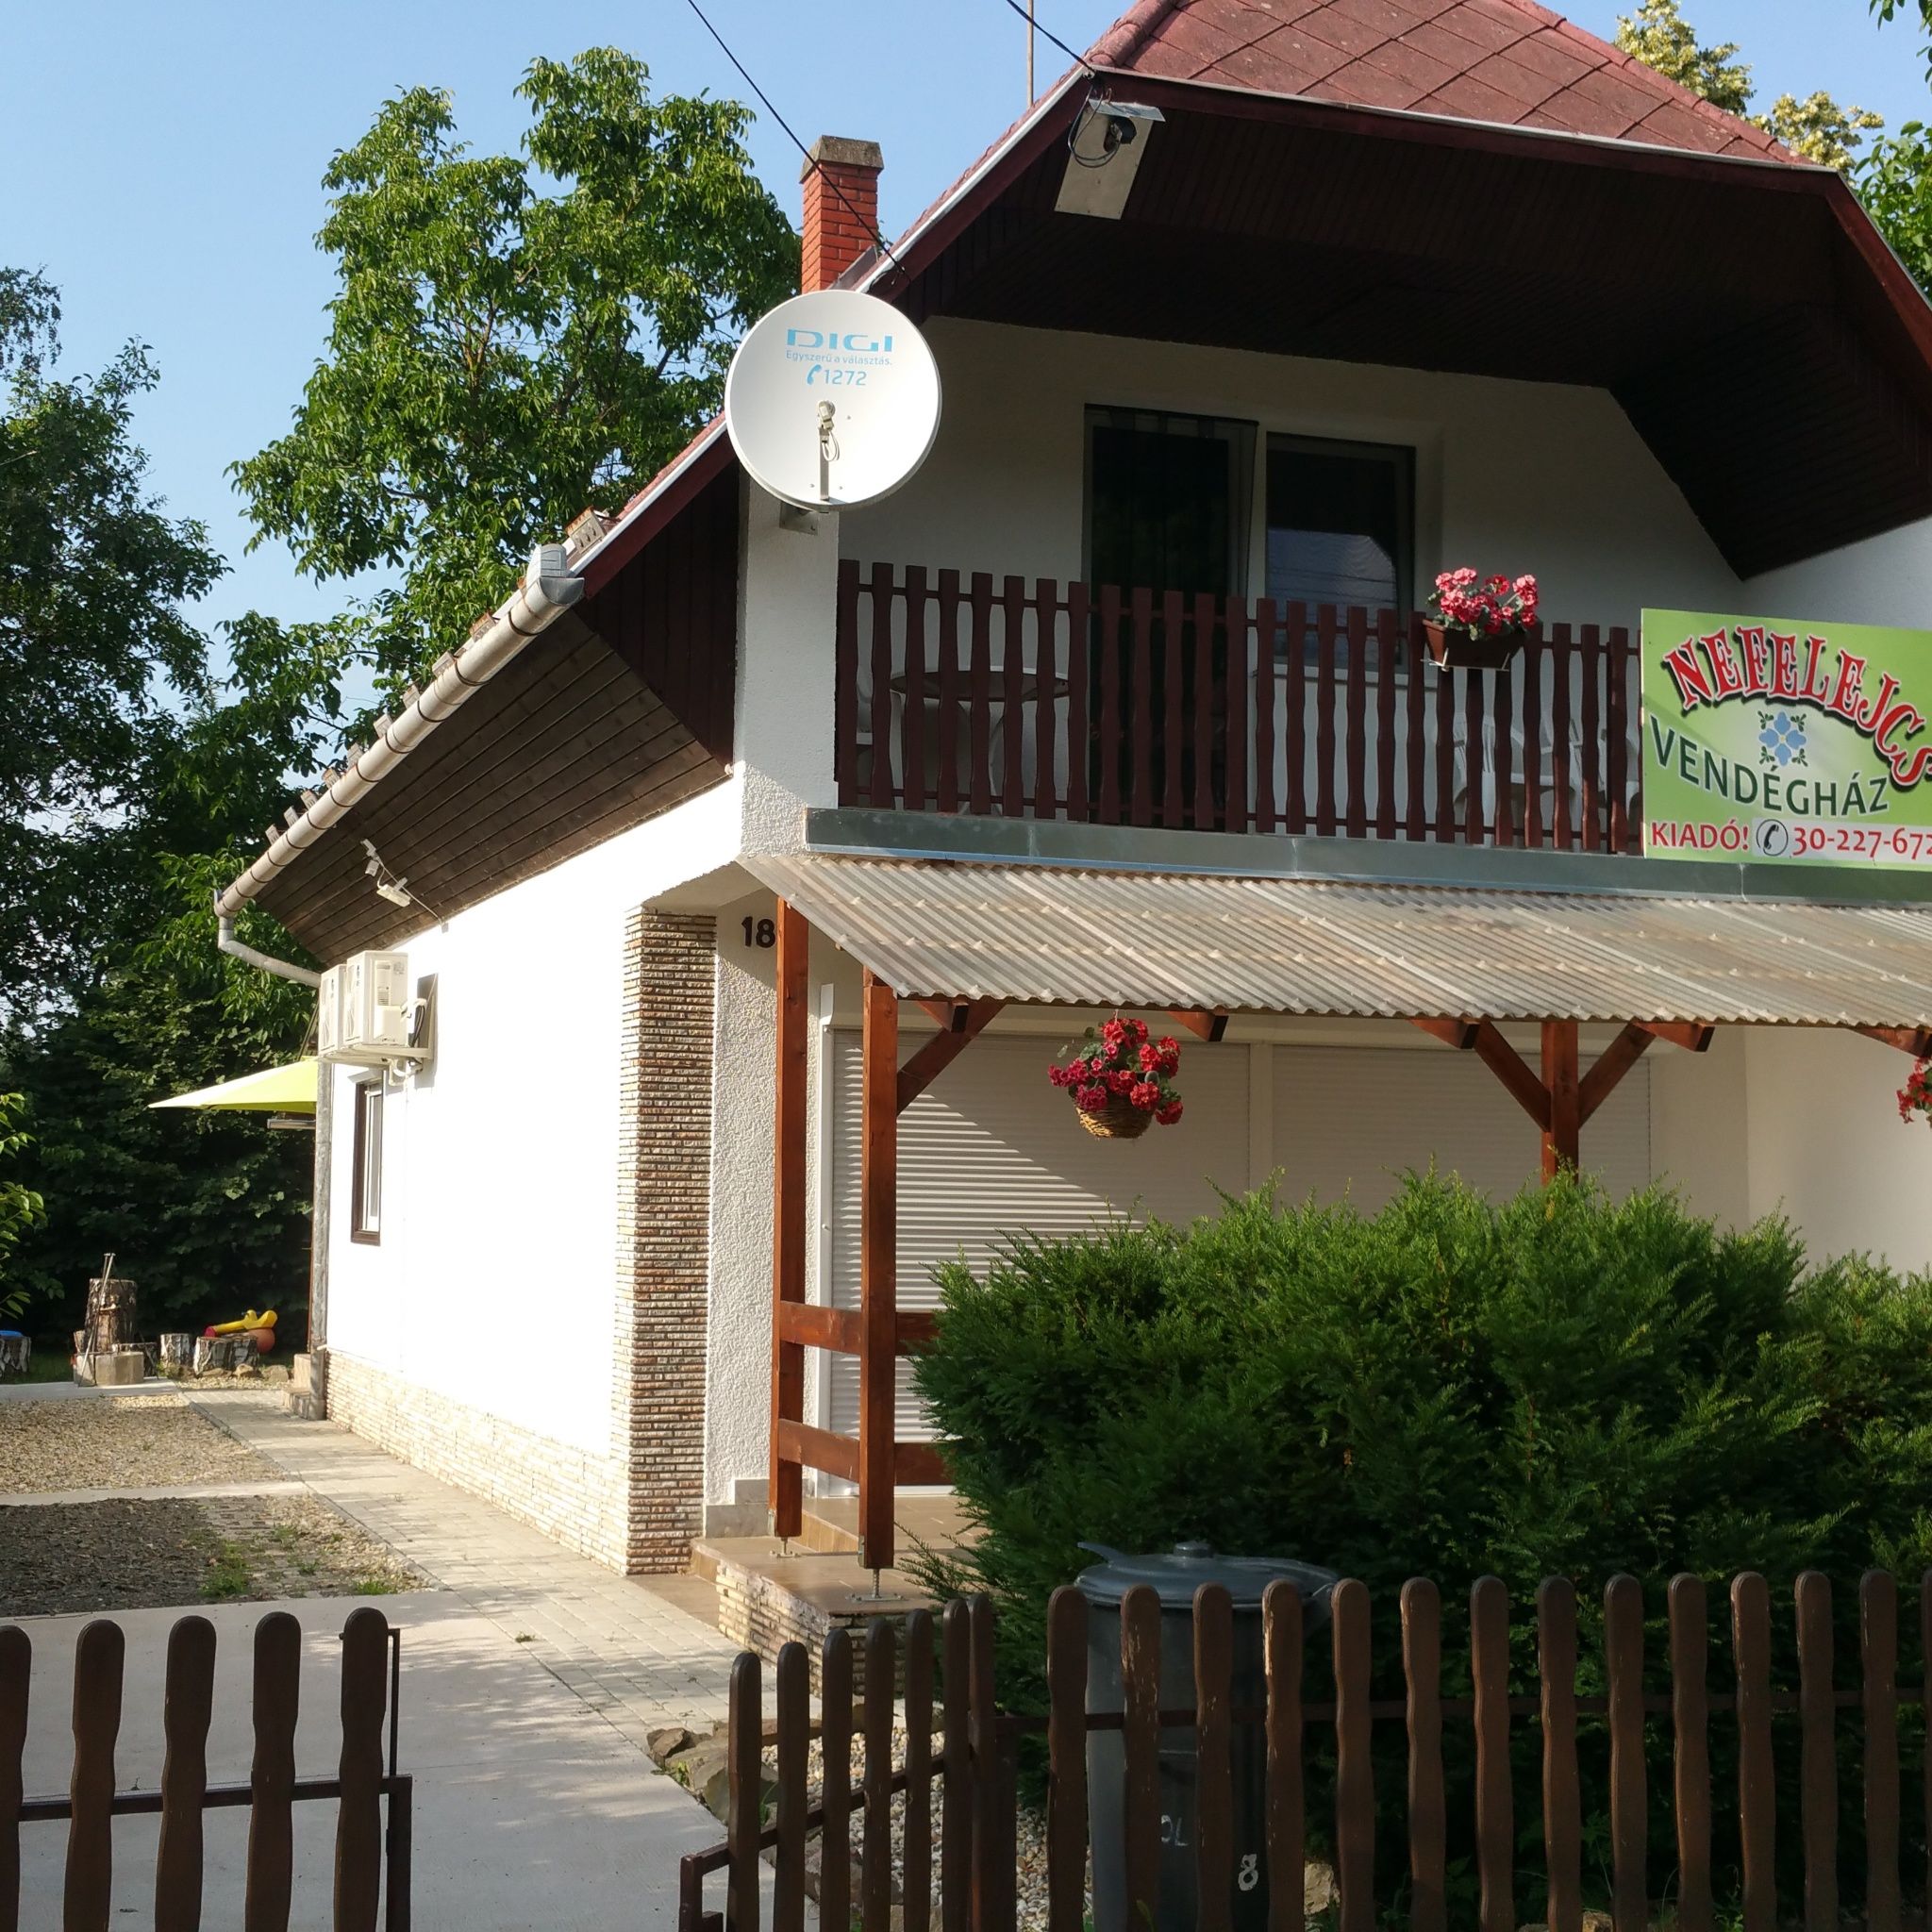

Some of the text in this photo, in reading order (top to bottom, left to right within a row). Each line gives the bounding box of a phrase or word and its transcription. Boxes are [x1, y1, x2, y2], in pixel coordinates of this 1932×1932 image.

[787, 328, 892, 352] DIGI
[824, 369, 867, 386] 1272
[1664, 625, 1932, 786] NEFELEJCS
[1651, 714, 1888, 816] VENDÉGHÁZ
[1651, 820, 1749, 851] KIADÓ!
[741, 916, 776, 949] 18
[1238, 1853, 1259, 1891] 8
